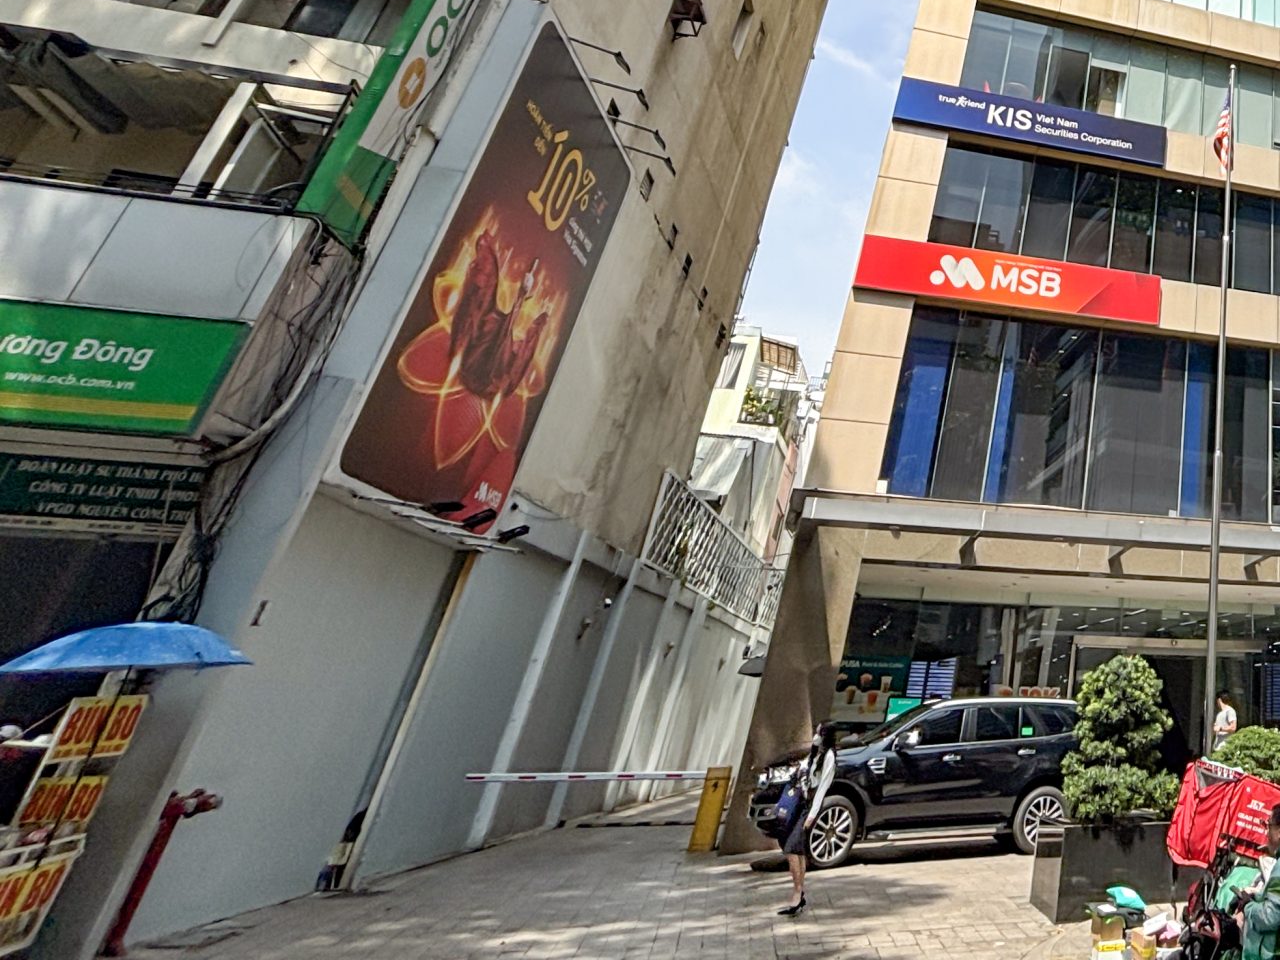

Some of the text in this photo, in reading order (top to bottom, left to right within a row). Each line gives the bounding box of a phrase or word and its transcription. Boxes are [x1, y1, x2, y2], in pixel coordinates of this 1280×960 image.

[986, 104, 1033, 131] KIS
[1056, 117, 1079, 129] Nam
[1034, 124, 1133, 150] Securities Corporation
[527, 131, 596, 232] 10%
[990, 264, 1062, 298] MSB
[72, 338, 155, 371] Đông
[4, 370, 136, 390] www.ocb.com.vn
